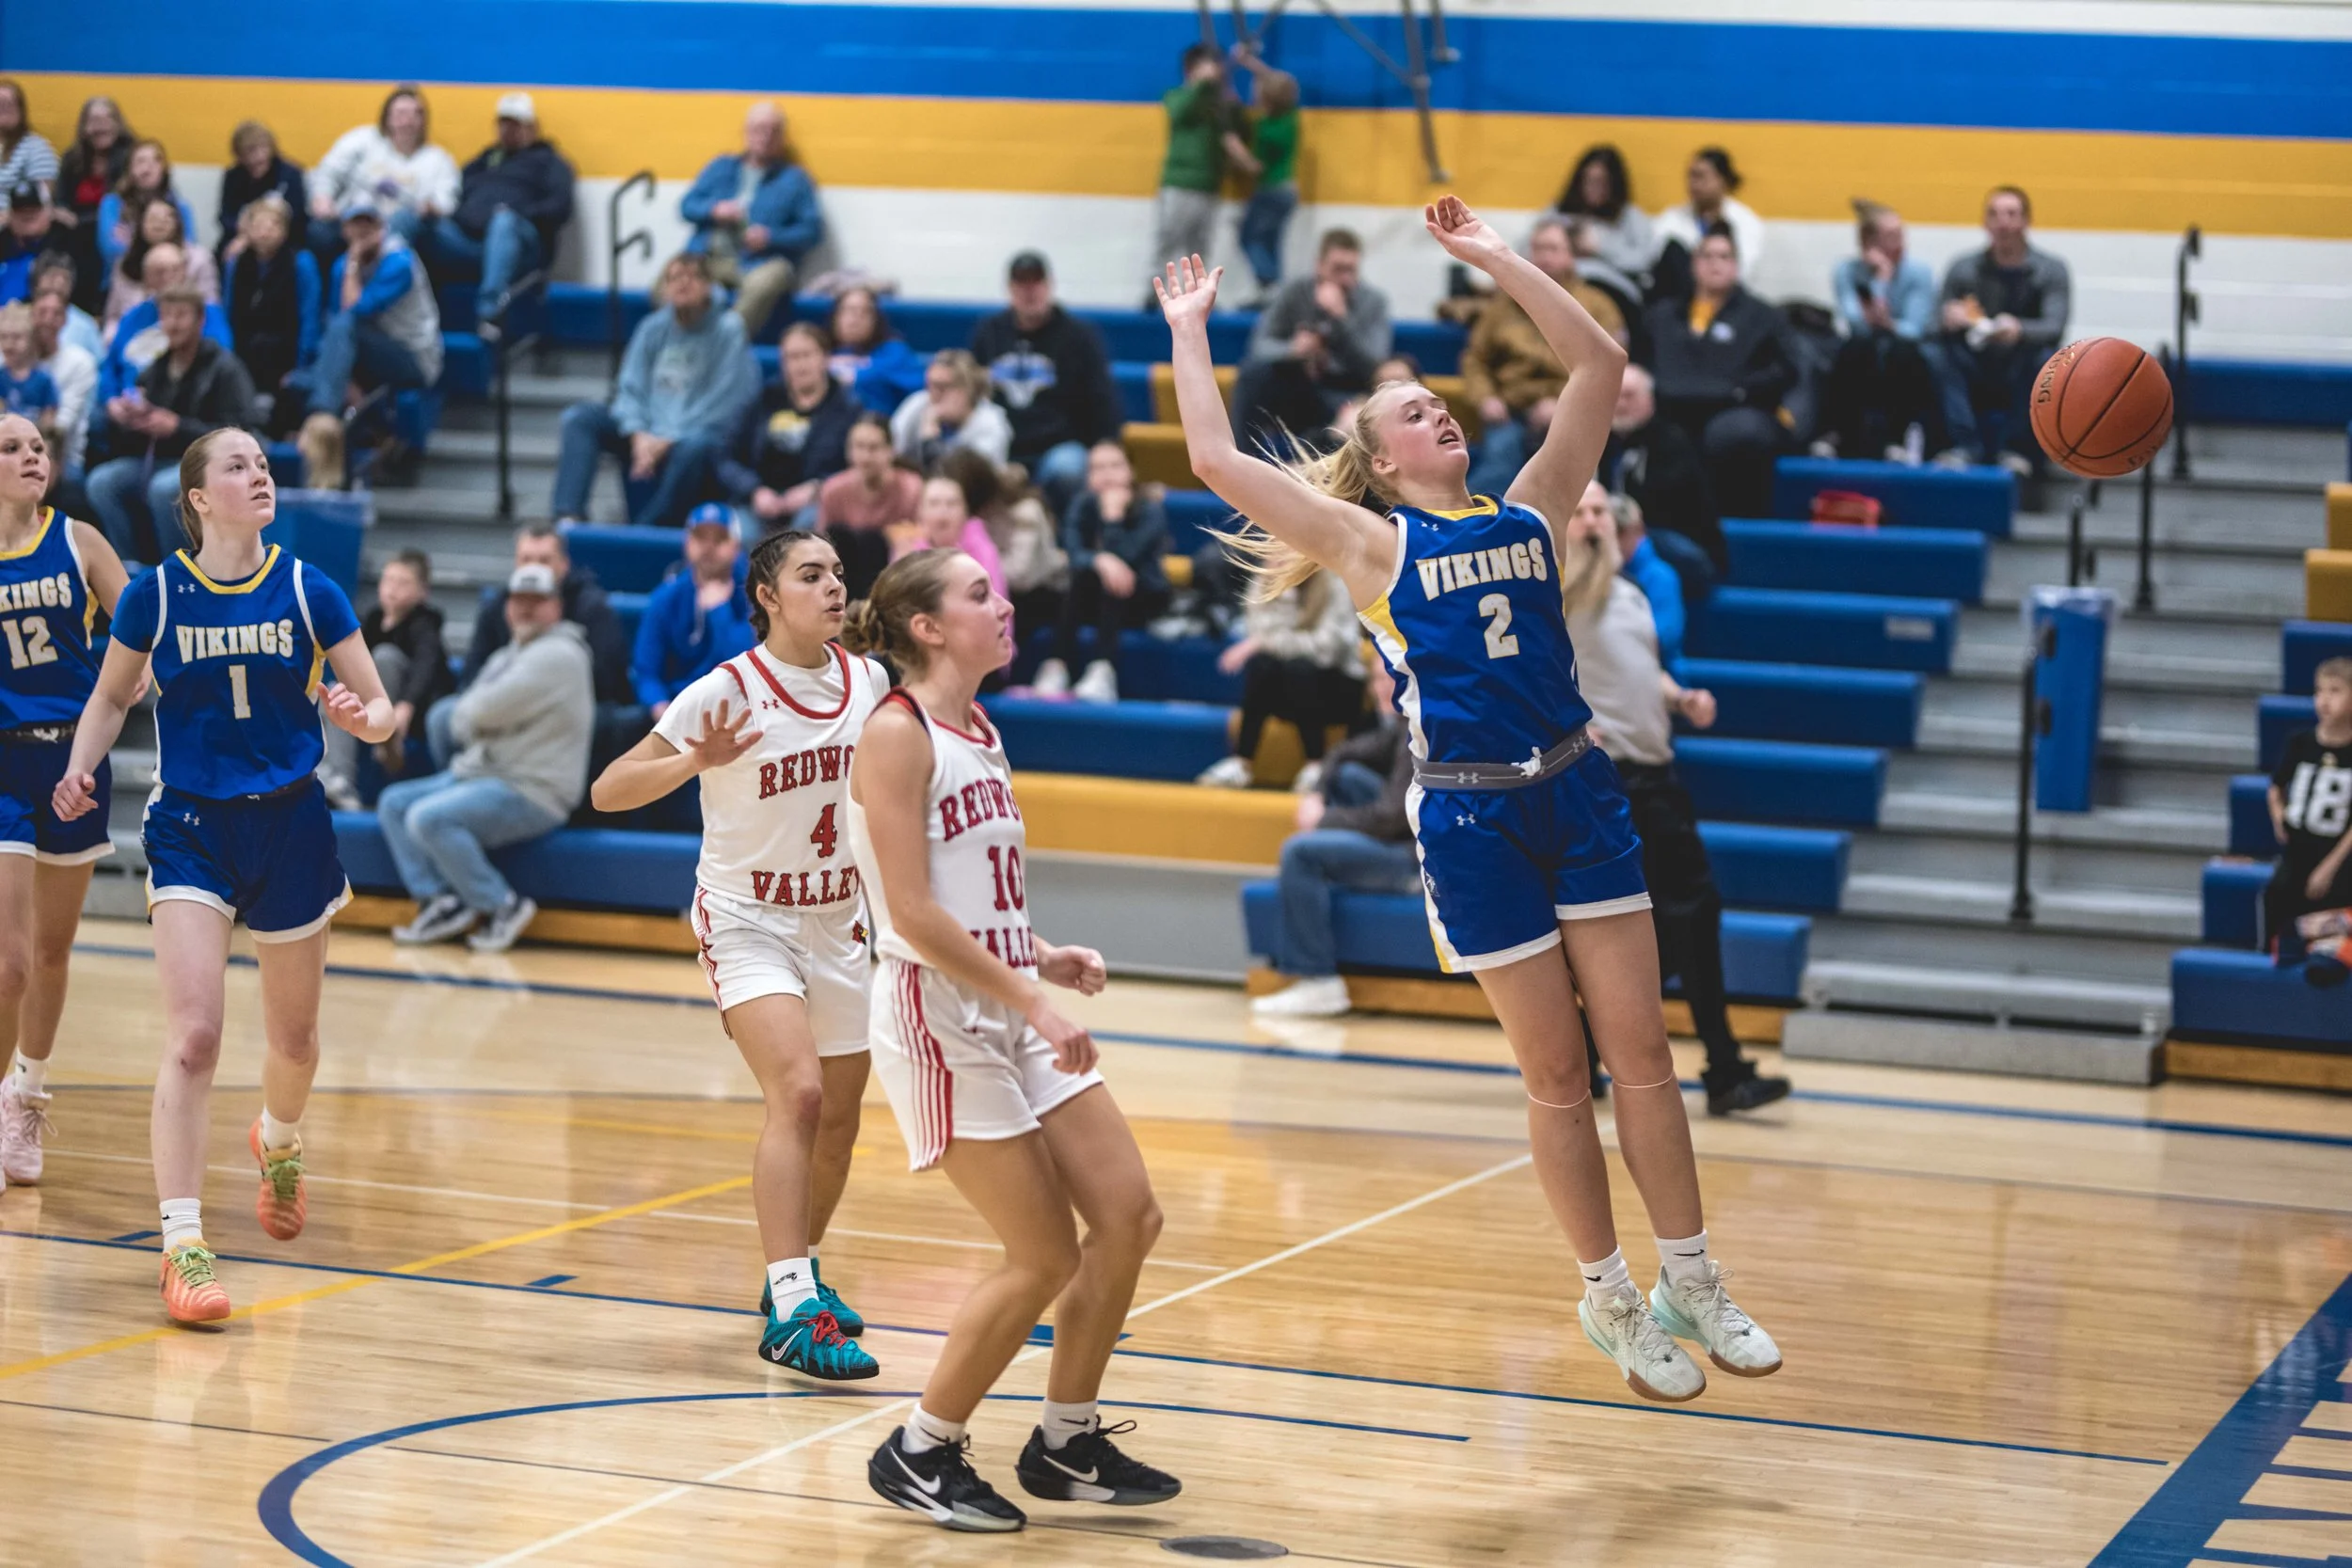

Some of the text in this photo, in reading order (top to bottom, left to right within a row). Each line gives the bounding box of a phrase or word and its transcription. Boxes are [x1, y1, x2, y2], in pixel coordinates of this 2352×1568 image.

[1415, 537, 1548, 602] VIKINGS
[2, 615, 58, 670] 12
[175, 618, 294, 664] VIKINGS
[1478, 593, 1520, 659] 2
[229, 664, 251, 720] 1
[810, 802, 838, 858] 4
[2284, 762, 2352, 838] 18
[987, 845, 1025, 911] 10
